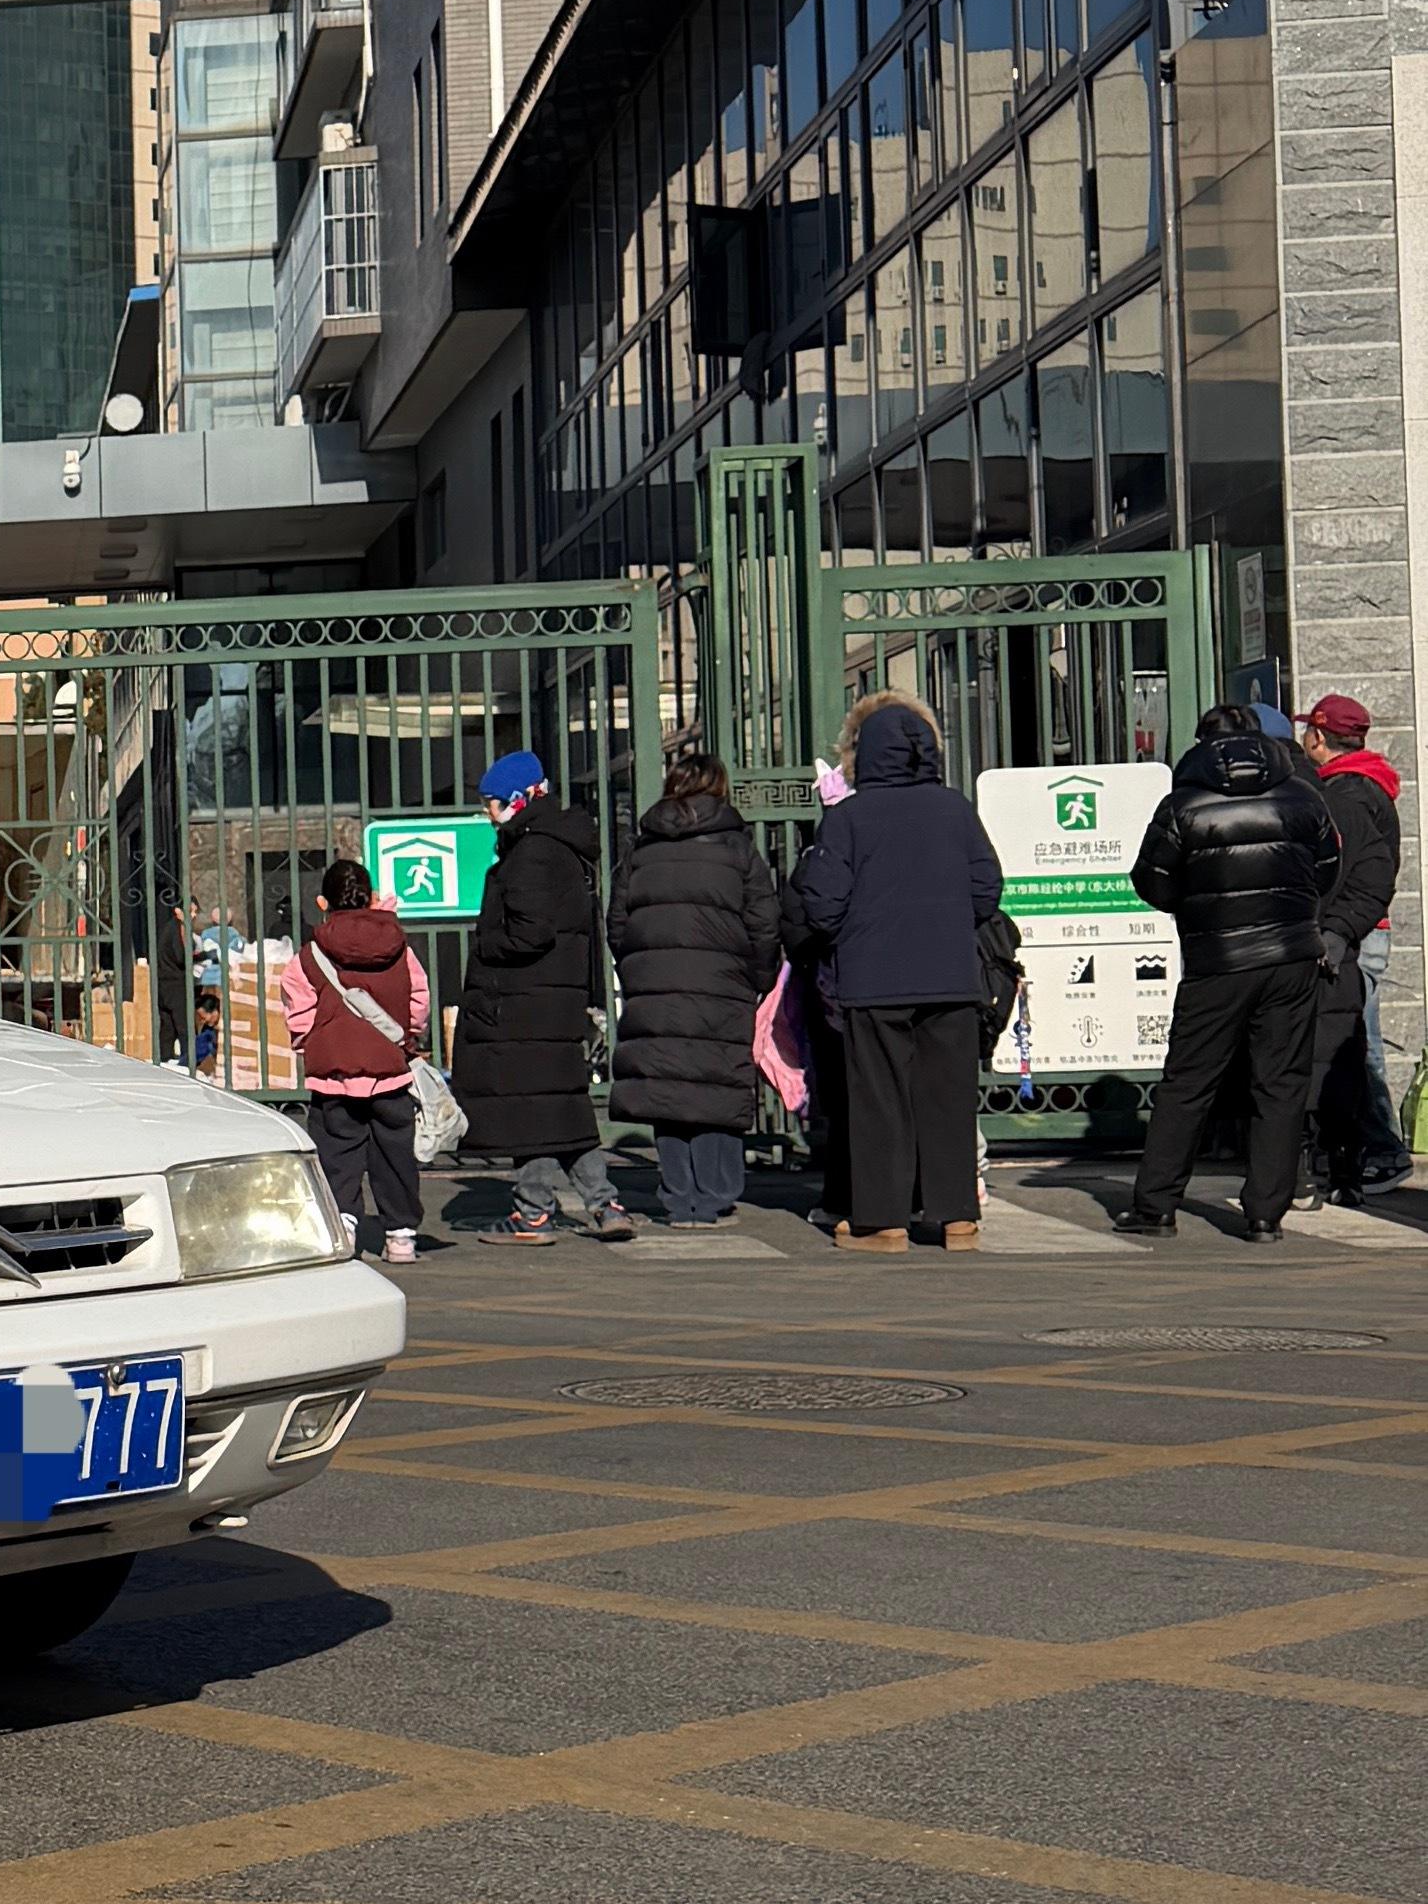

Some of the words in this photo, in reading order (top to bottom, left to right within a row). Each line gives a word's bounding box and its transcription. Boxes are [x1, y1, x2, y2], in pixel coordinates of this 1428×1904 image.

[1034, 840, 1122, 857] 应急避难场所
